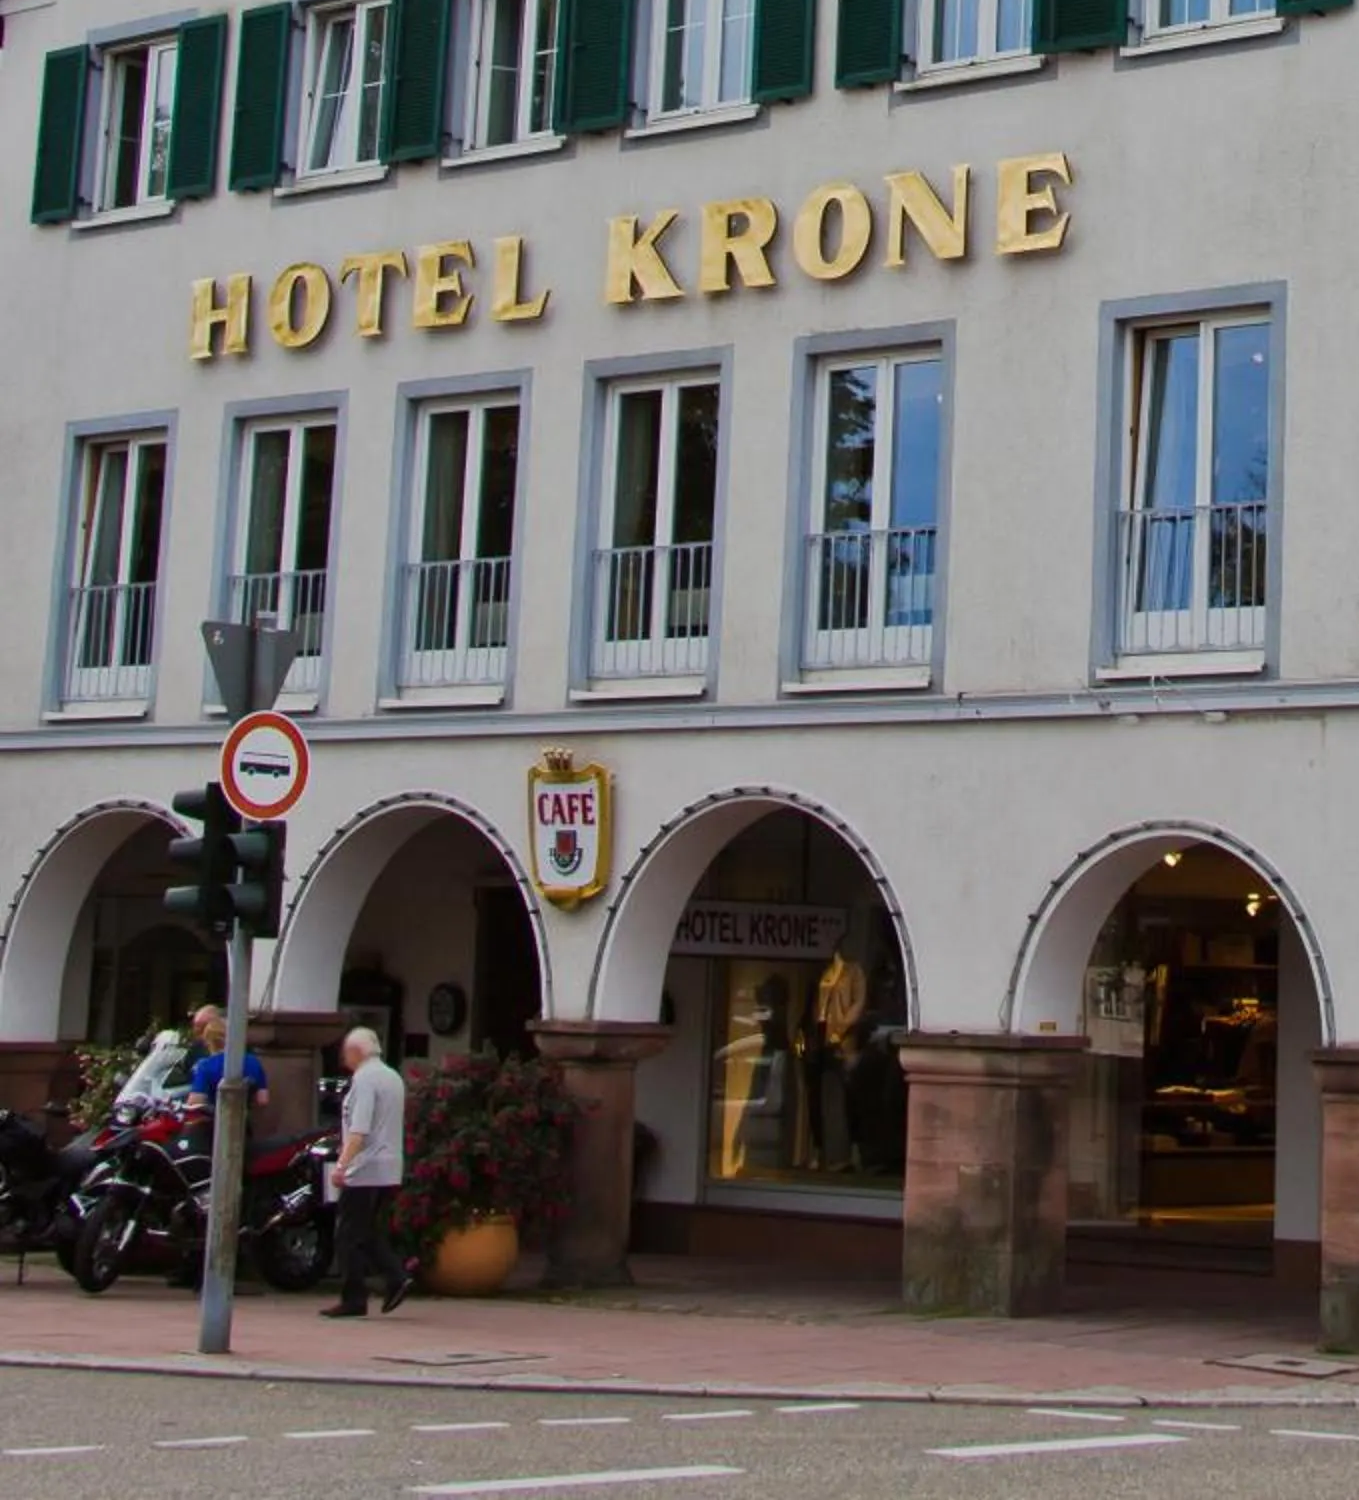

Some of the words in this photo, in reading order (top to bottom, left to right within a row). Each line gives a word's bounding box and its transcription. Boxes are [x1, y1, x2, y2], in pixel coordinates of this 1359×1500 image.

[189, 233, 552, 360] HOTEL
[604, 150, 1073, 305] KRONE
[537, 787, 595, 826] CAFÉ
[675, 909, 744, 945] HOTEL
[749, 912, 819, 949] KRONE
